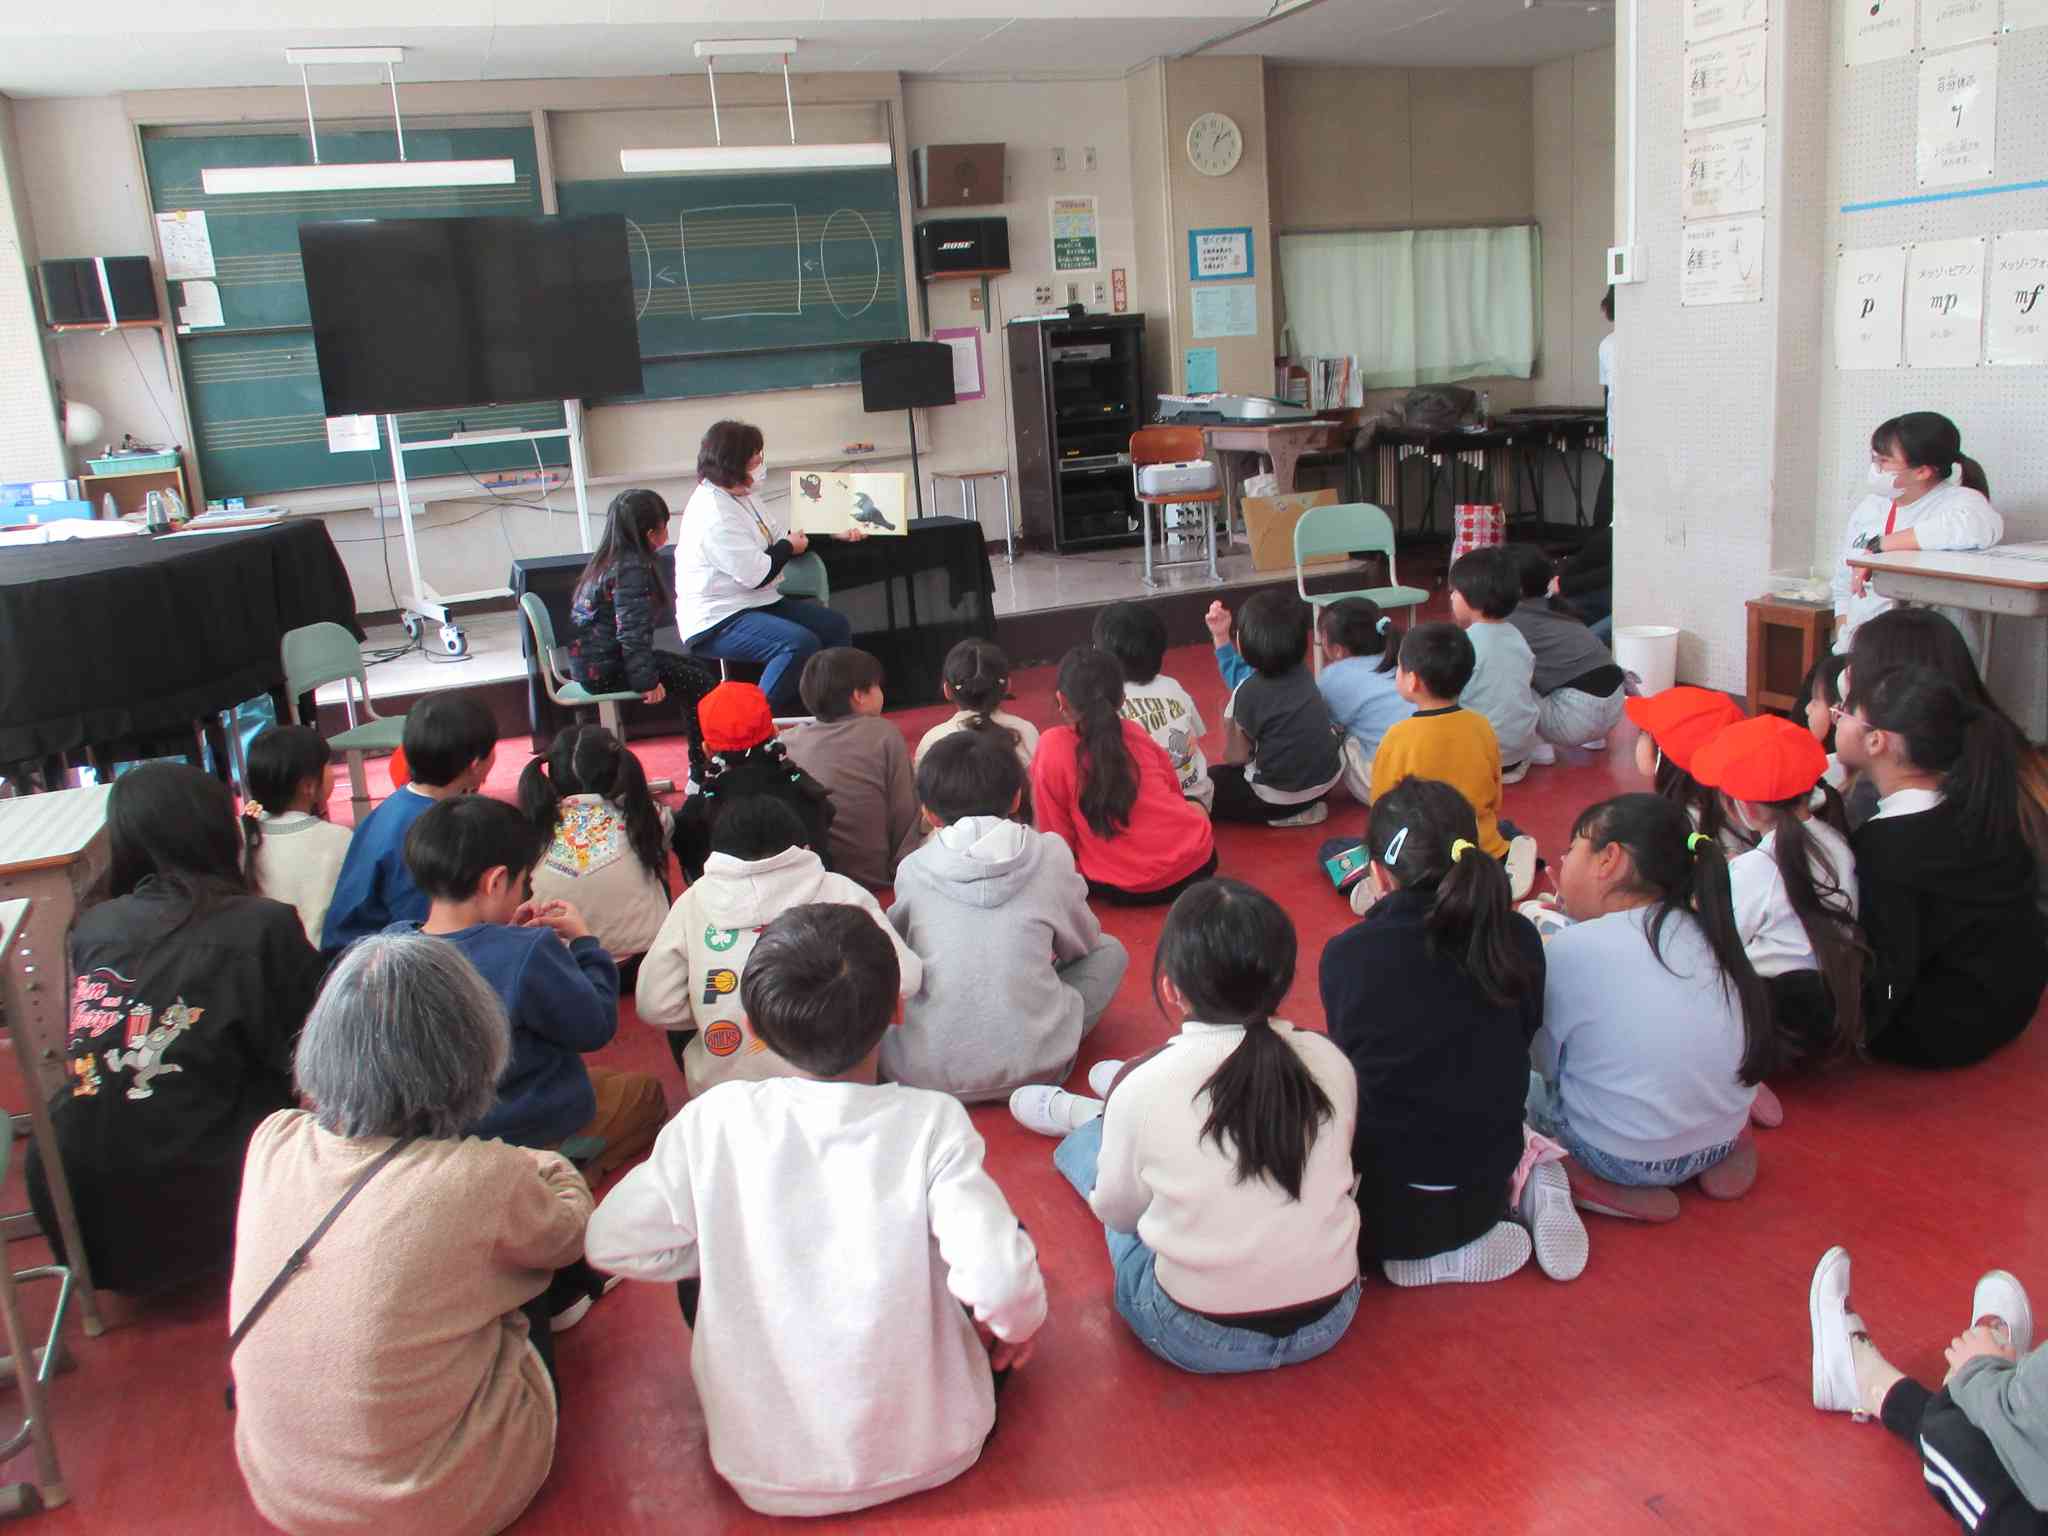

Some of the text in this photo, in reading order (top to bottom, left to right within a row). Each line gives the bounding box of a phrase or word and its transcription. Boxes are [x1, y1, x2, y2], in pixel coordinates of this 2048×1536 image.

[937, 241, 975, 251] BOSE
[1860, 297, 1875, 319] p
[1930, 293, 1958, 315] mp
[2015, 284, 2044, 314] mf
[1138, 711, 1168, 735] YOU
